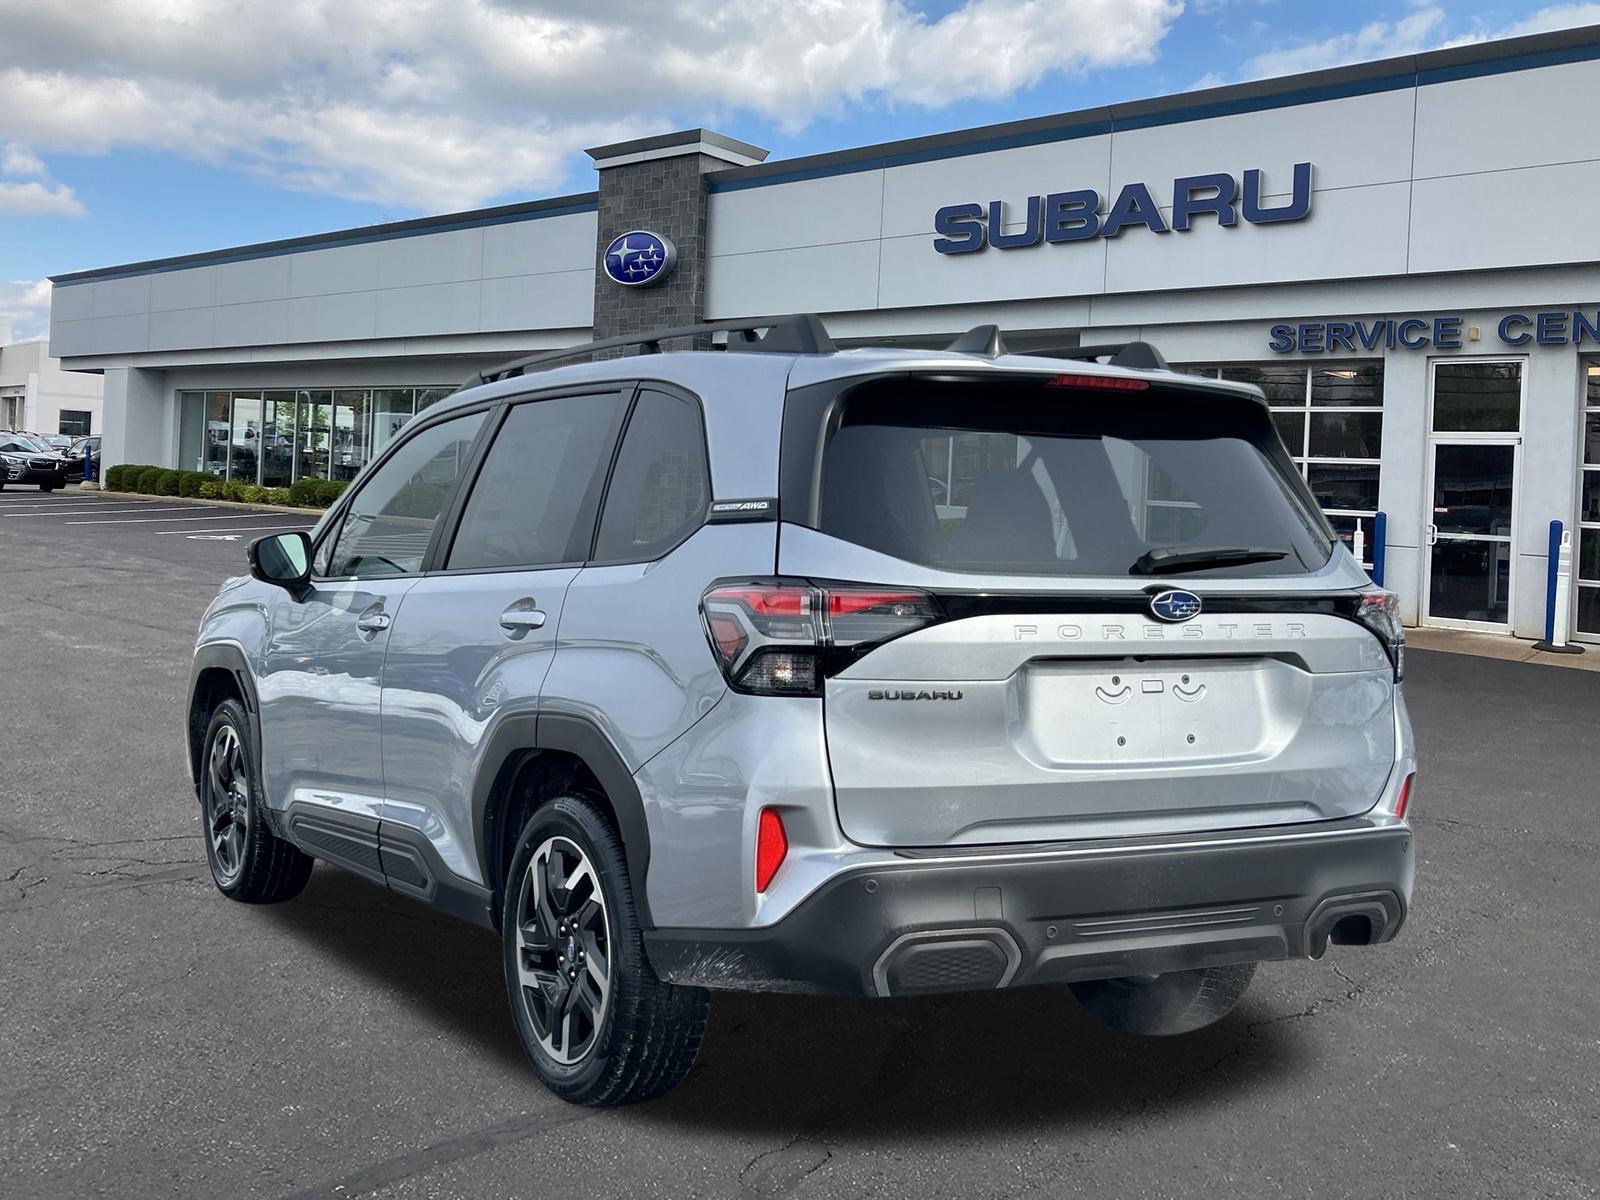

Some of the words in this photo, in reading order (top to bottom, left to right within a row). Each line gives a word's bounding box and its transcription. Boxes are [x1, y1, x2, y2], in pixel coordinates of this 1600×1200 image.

[933, 162, 1312, 255] SUBARU
[1269, 317, 1463, 353] SERVICE
[1497, 311, 1600, 346] CEN
[1013, 623, 1307, 641] FORESTER
[868, 690, 963, 701] SUBARU
